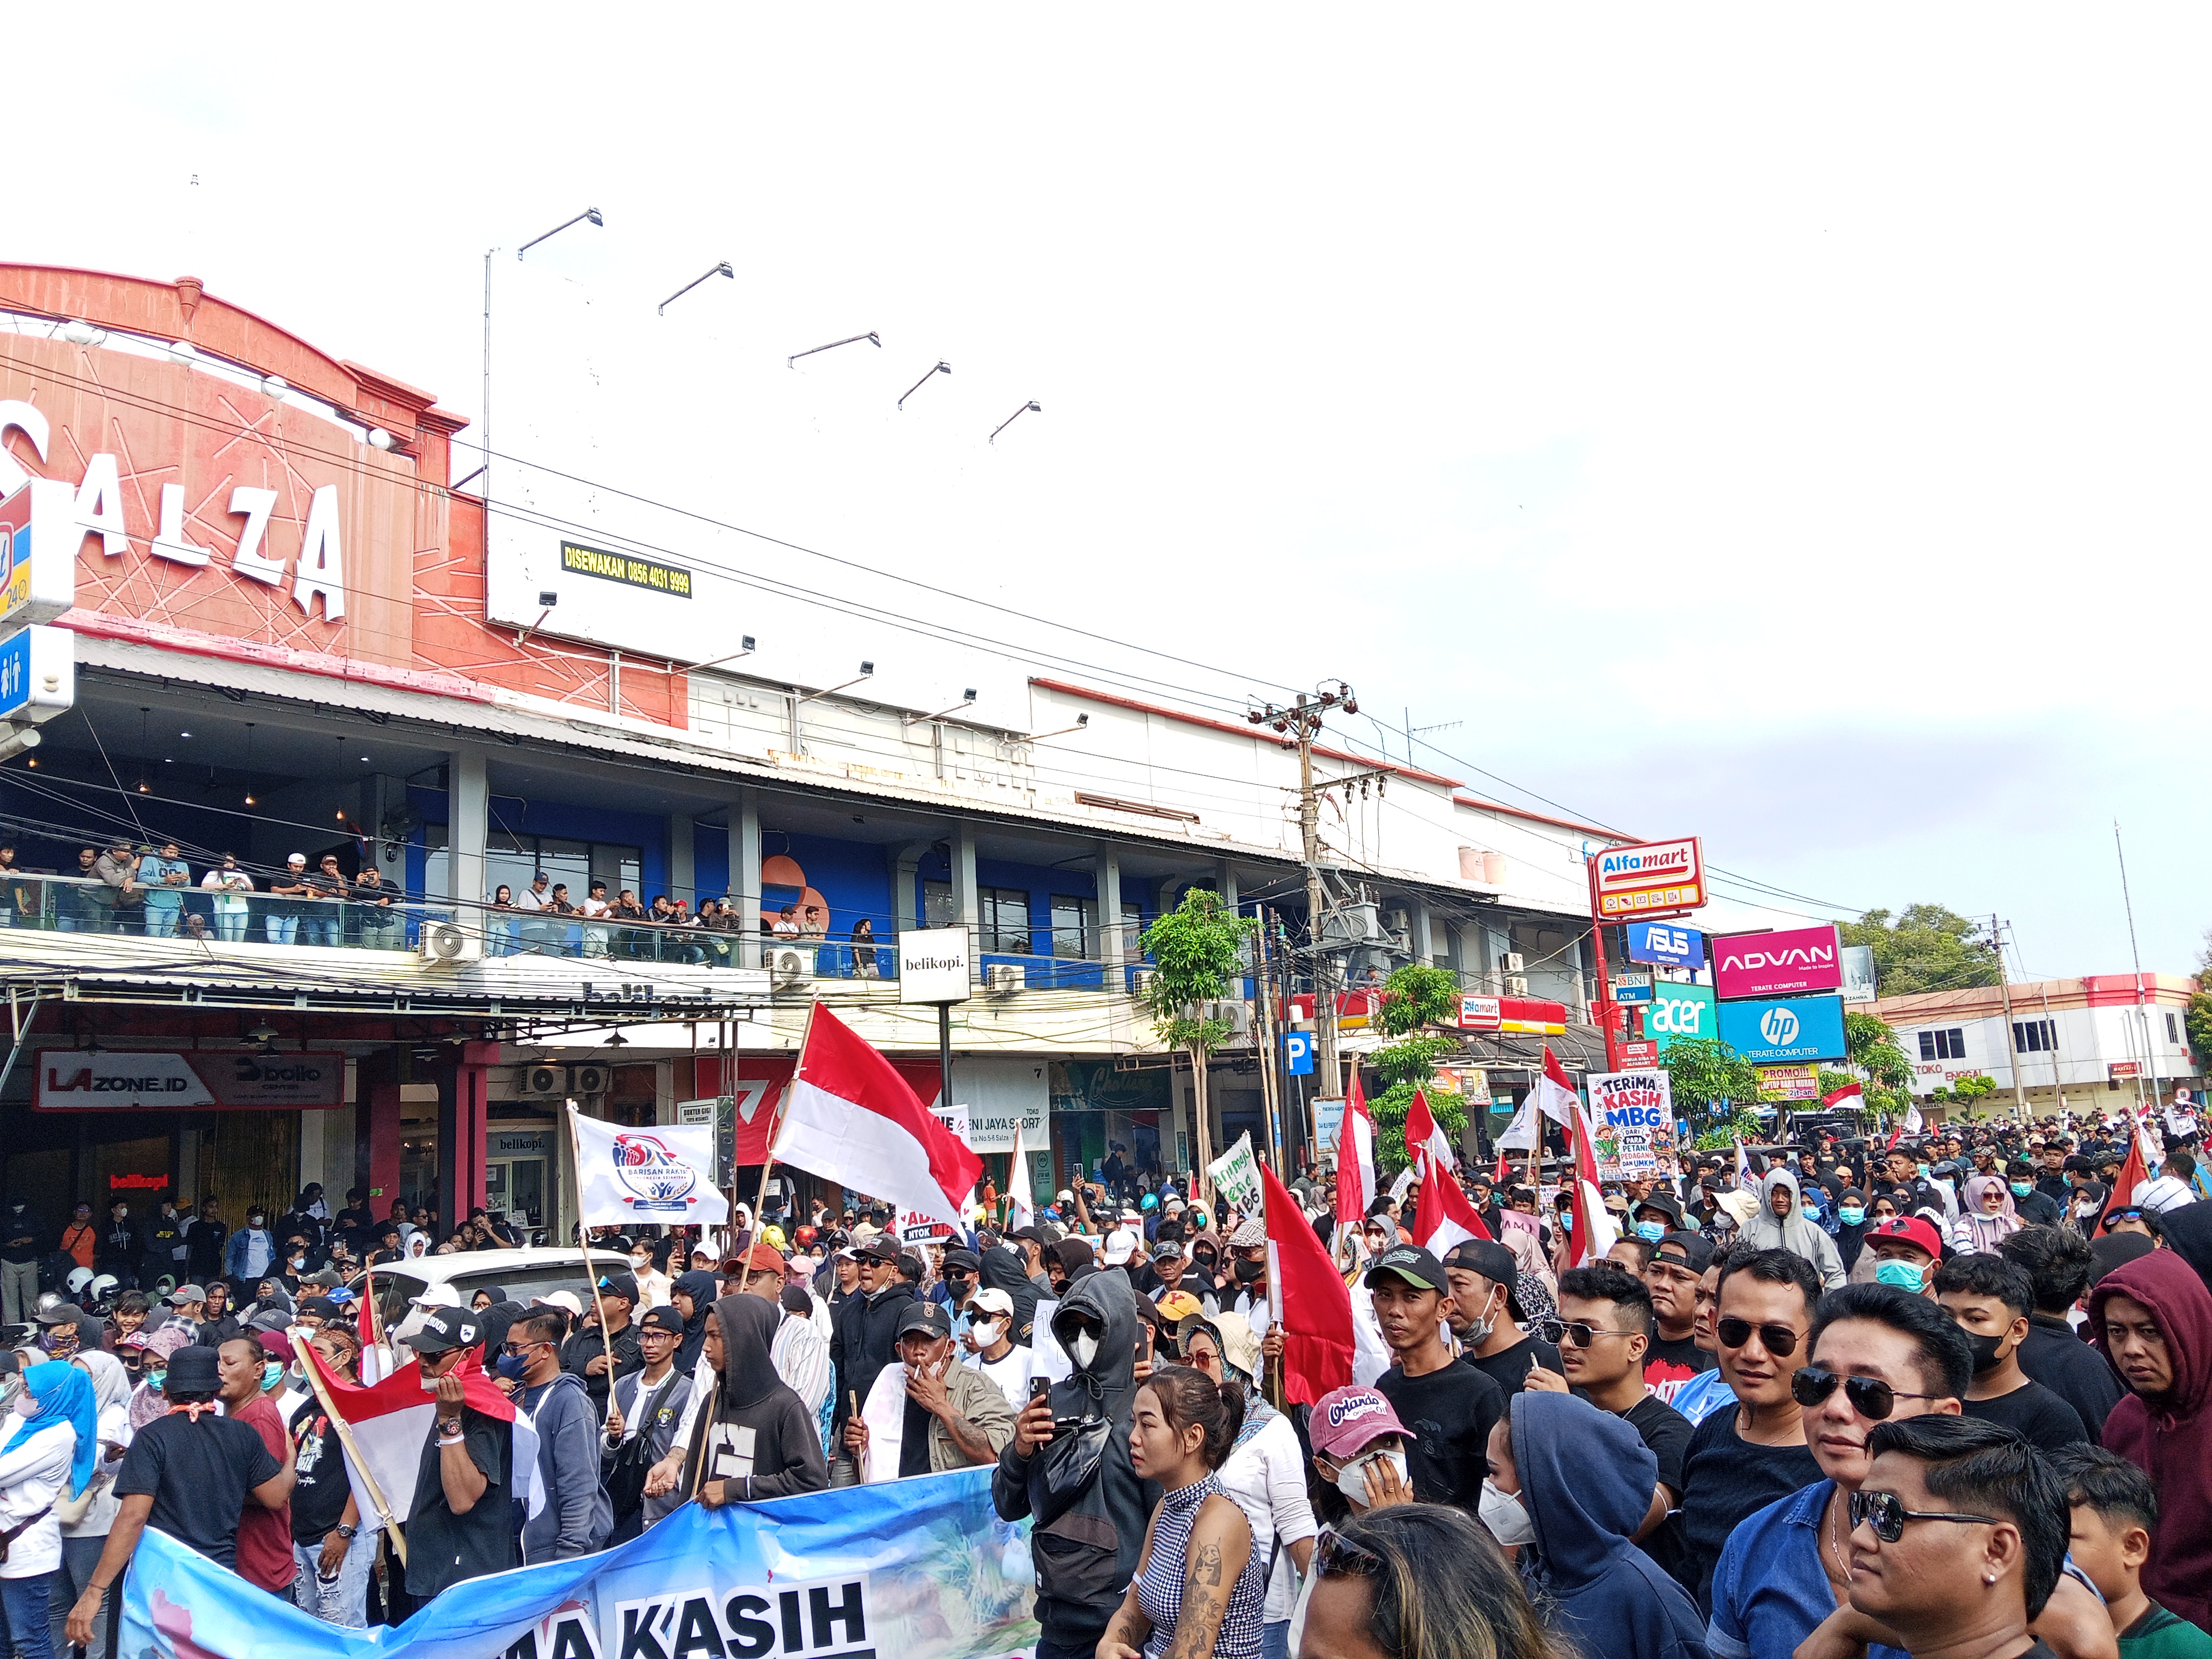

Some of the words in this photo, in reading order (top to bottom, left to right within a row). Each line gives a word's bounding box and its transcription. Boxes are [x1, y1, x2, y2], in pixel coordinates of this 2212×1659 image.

[564, 546, 625, 579] DISEWAKAN
[628, 561, 648, 584] 0856
[649, 566, 668, 589] 4031
[670, 571, 689, 594] 9999
[1603, 848, 1688, 873] Alfamart
[1645, 926, 1689, 955] ASUS
[1721, 945, 1833, 972] ADVAN
[1627, 976, 1645, 985] BNI
[1751, 984, 1773, 992] TERATE
[1773, 981, 1808, 990] COMPUTER
[1653, 997, 1706, 1034] acer
[1764, 1008, 1796, 1046] hp
[1289, 1038, 1305, 1070] P
[1747, 1049, 1775, 1058] TERATE
[1775, 1048, 1819, 1057] COMPUTER
[1763, 1068, 1809, 1078] PROMO!!!
[1914, 1064, 1943, 1075] TOKO
[684, 1108, 701, 1116] DOKTER
[984, 1117, 1008, 1130] JAYA
[1009, 1117, 1040, 1130] SORT
[1605, 1107, 1661, 1127] MBG
[1330, 1394, 1380, 1425] Orlando
[619, 1582, 866, 1659] KASIH
